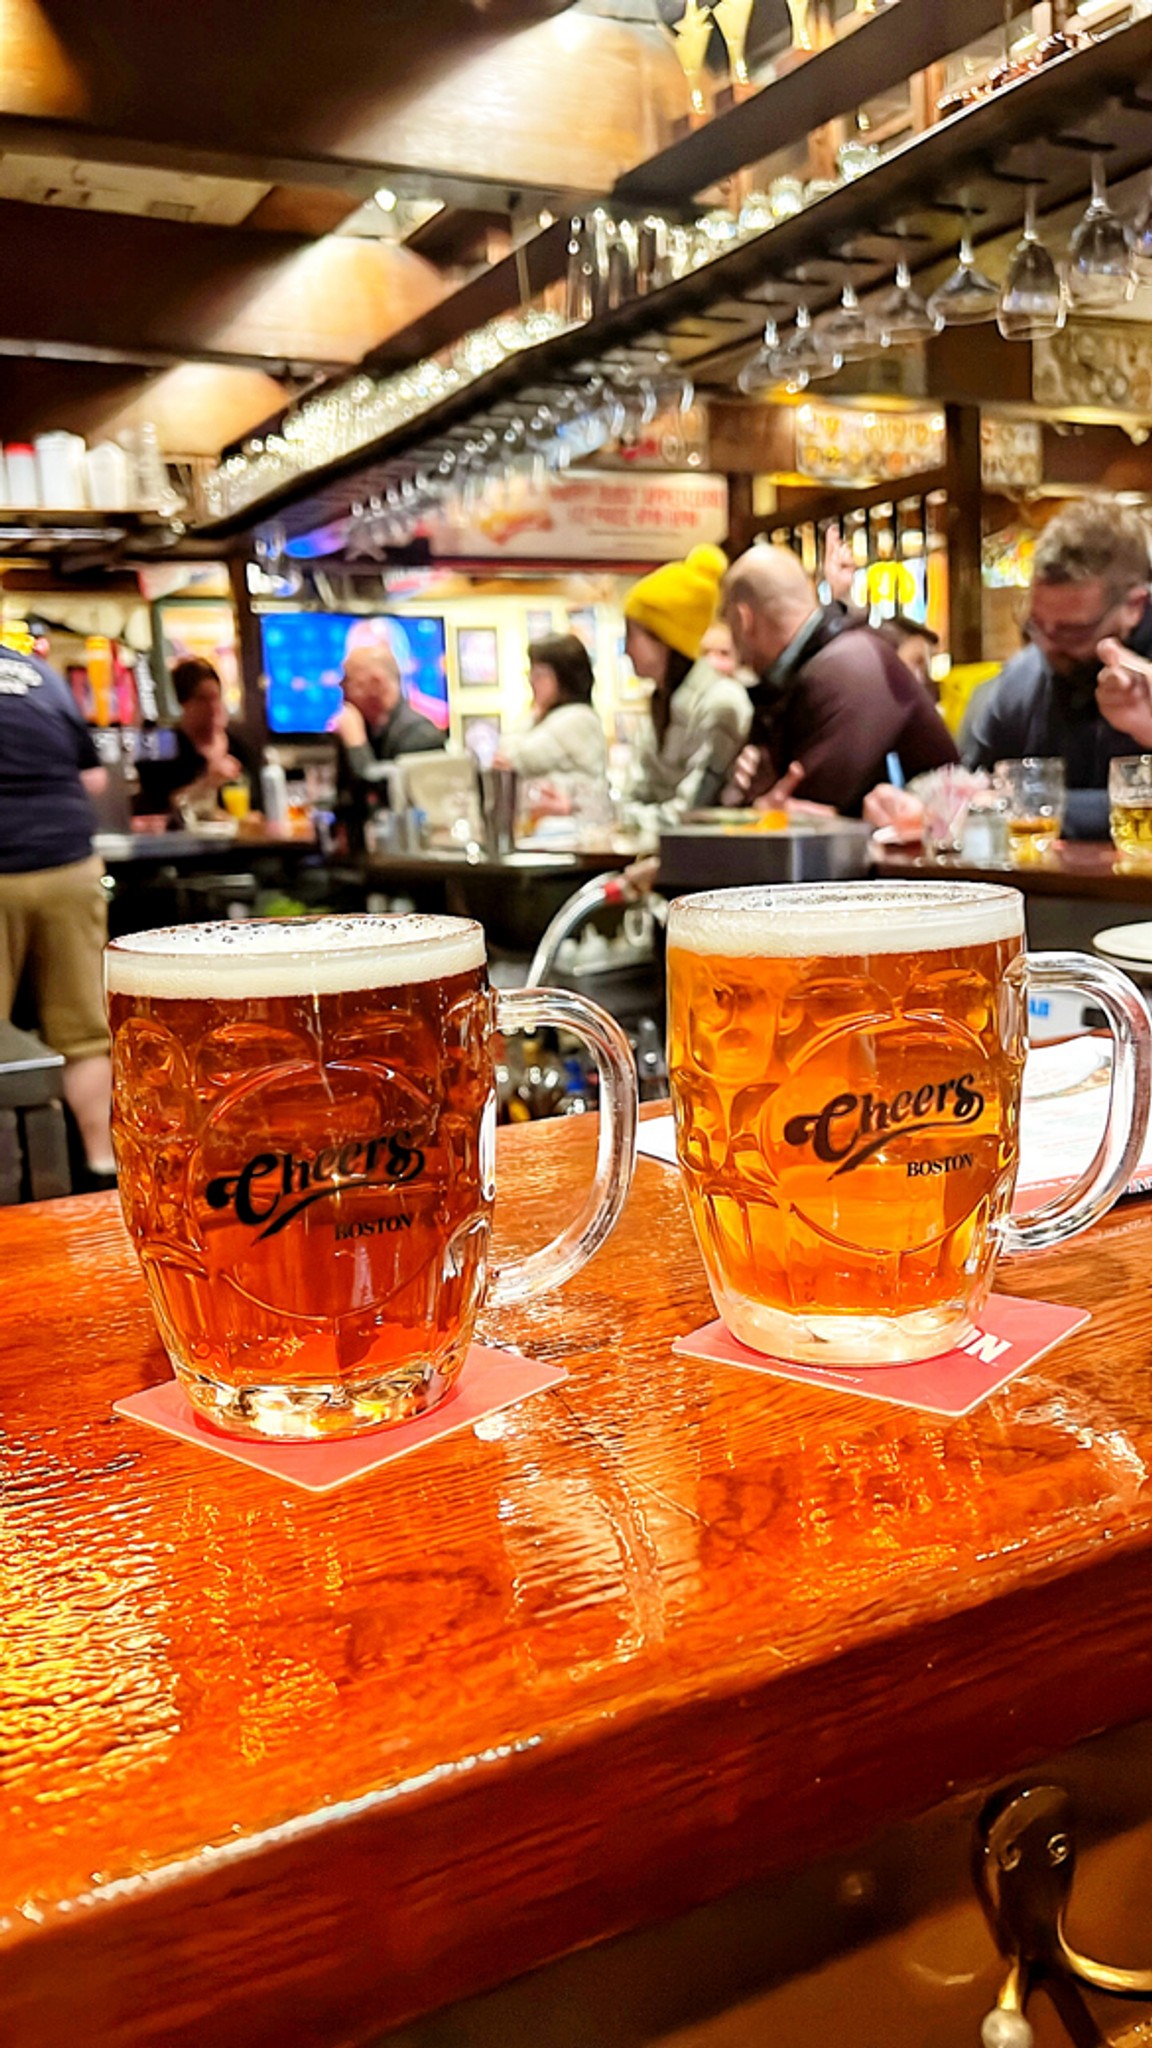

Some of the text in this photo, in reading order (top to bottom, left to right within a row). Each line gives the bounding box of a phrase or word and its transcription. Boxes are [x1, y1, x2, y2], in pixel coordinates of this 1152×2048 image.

[784, 1073, 985, 1181] Cheers
[205, 1130, 425, 1244] Cheers
[907, 1152, 982, 1178] BOSTON
[334, 1212, 412, 1241] BOSTON
